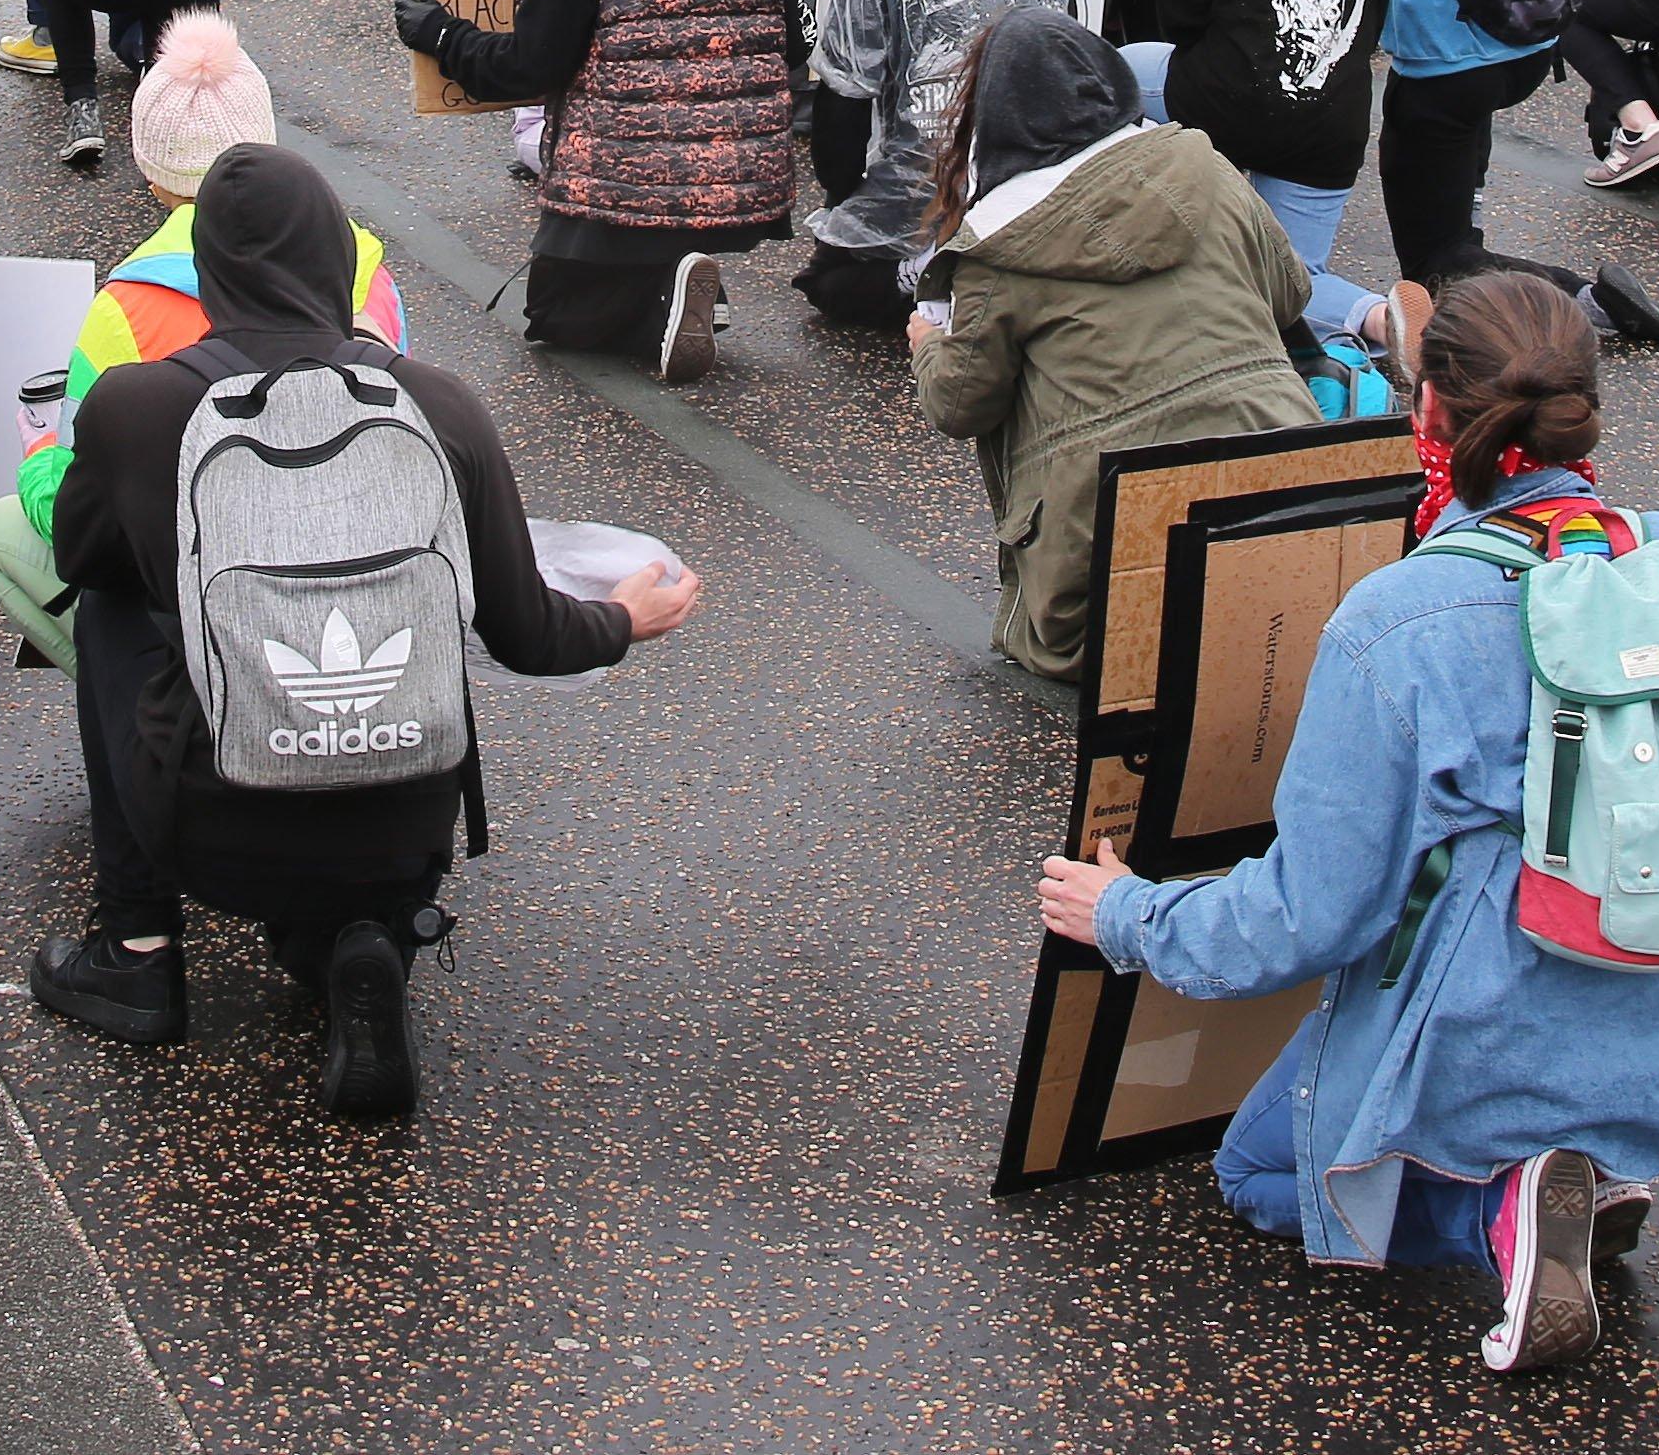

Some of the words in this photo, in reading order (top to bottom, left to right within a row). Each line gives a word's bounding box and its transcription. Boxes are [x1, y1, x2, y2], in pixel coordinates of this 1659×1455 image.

[1251, 612, 1285, 764] Waterstones.com
[269, 718, 423, 756] adidas
[1093, 803, 1131, 819] Gardeco
